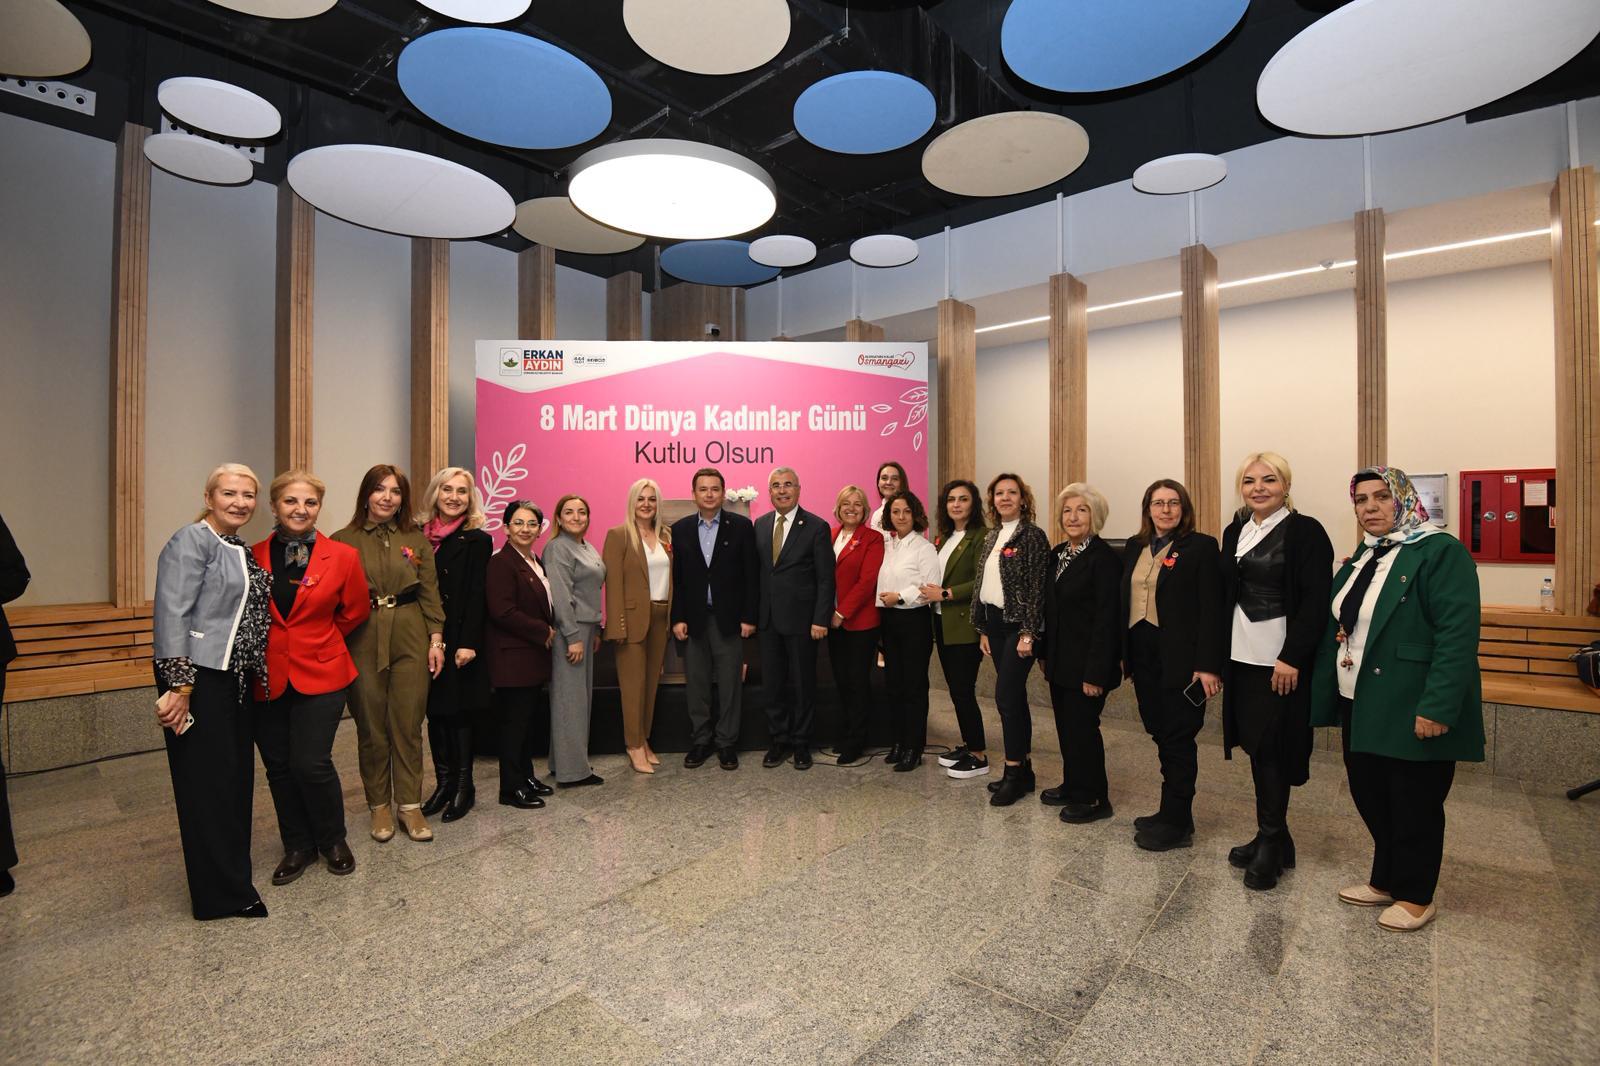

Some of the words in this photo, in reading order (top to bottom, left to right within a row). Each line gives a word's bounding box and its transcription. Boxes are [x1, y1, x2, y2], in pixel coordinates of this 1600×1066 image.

[524, 350, 563, 359] ERKAN
[858, 354, 909, 368] Osmangazi
[525, 361, 561, 370] AYDIN
[540, 404, 554, 431] 8
[562, 405, 617, 431] Mart
[624, 404, 696, 436] Dünya
[704, 405, 801, 431] Kadınlar
[808, 404, 866, 431] Günü
[635, 441, 696, 463] Kutlu
[705, 441, 774, 464] Olsun
